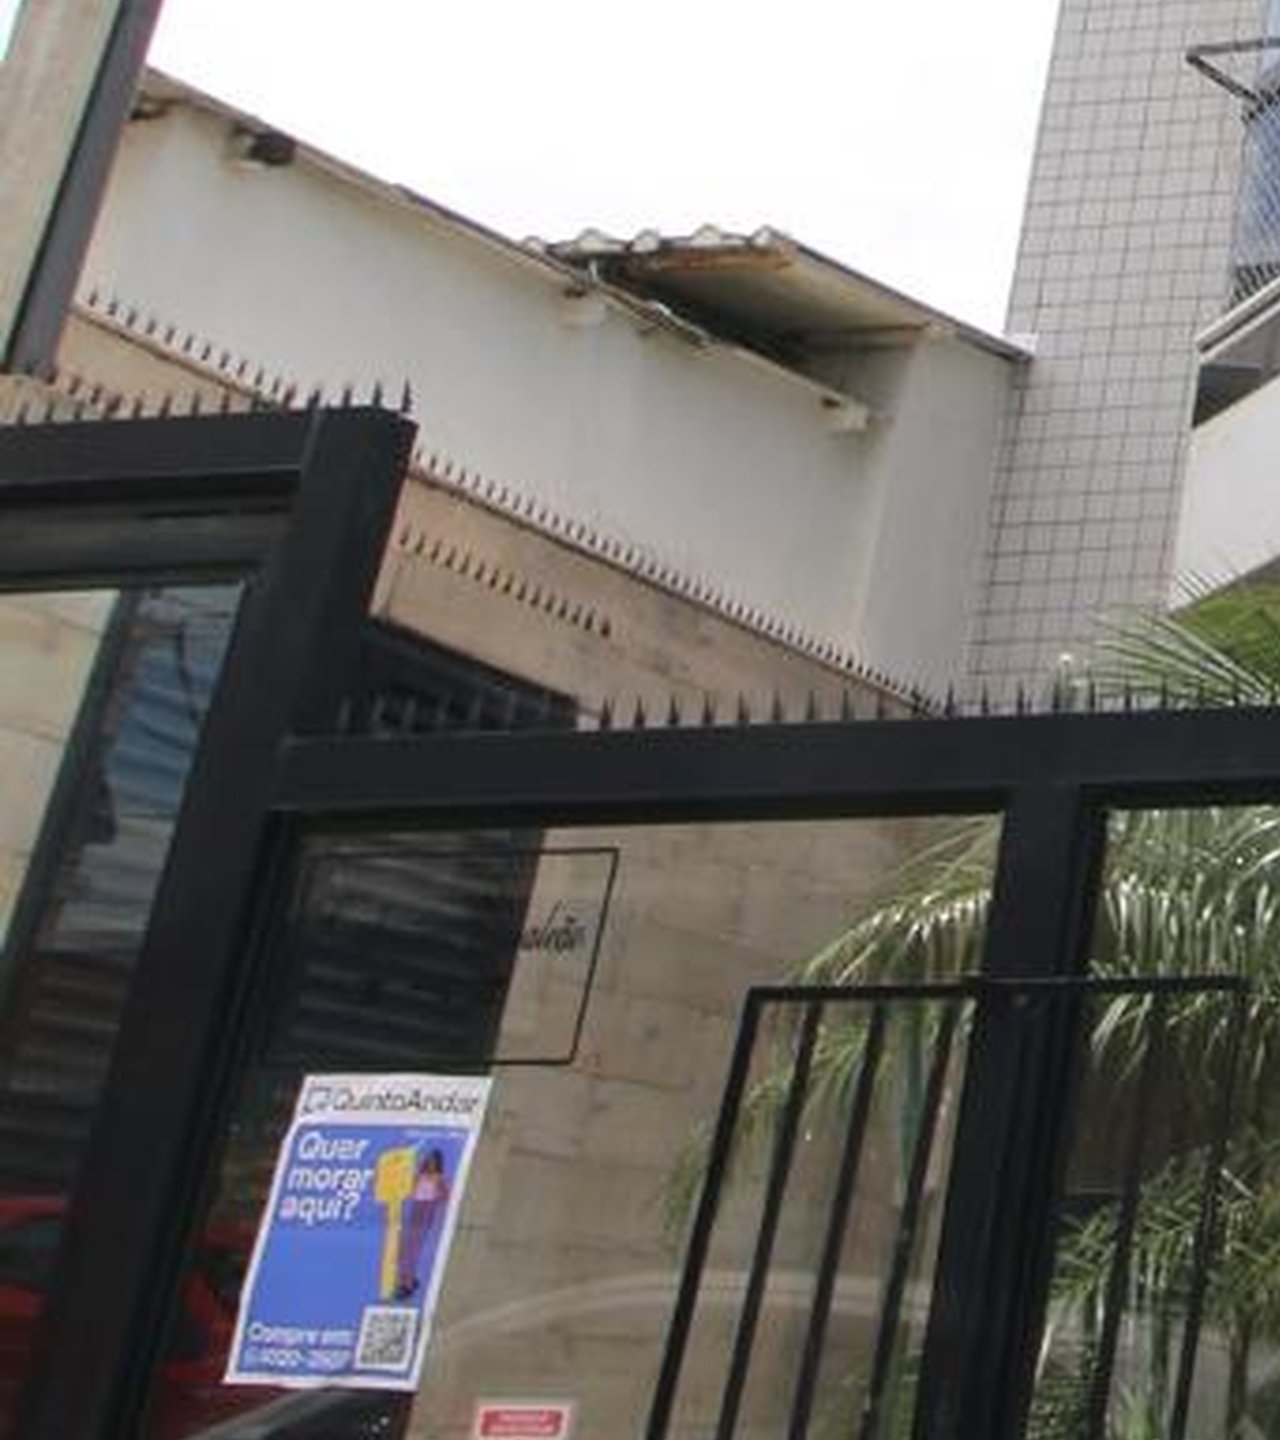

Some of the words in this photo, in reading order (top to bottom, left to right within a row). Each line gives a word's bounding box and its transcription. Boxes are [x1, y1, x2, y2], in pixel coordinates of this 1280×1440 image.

[332, 1086, 480, 1114] QuintoAndar
[298, 1130, 370, 1161] Quer
[287, 1166, 374, 1191] morar
[279, 1191, 359, 1225] aqui?
